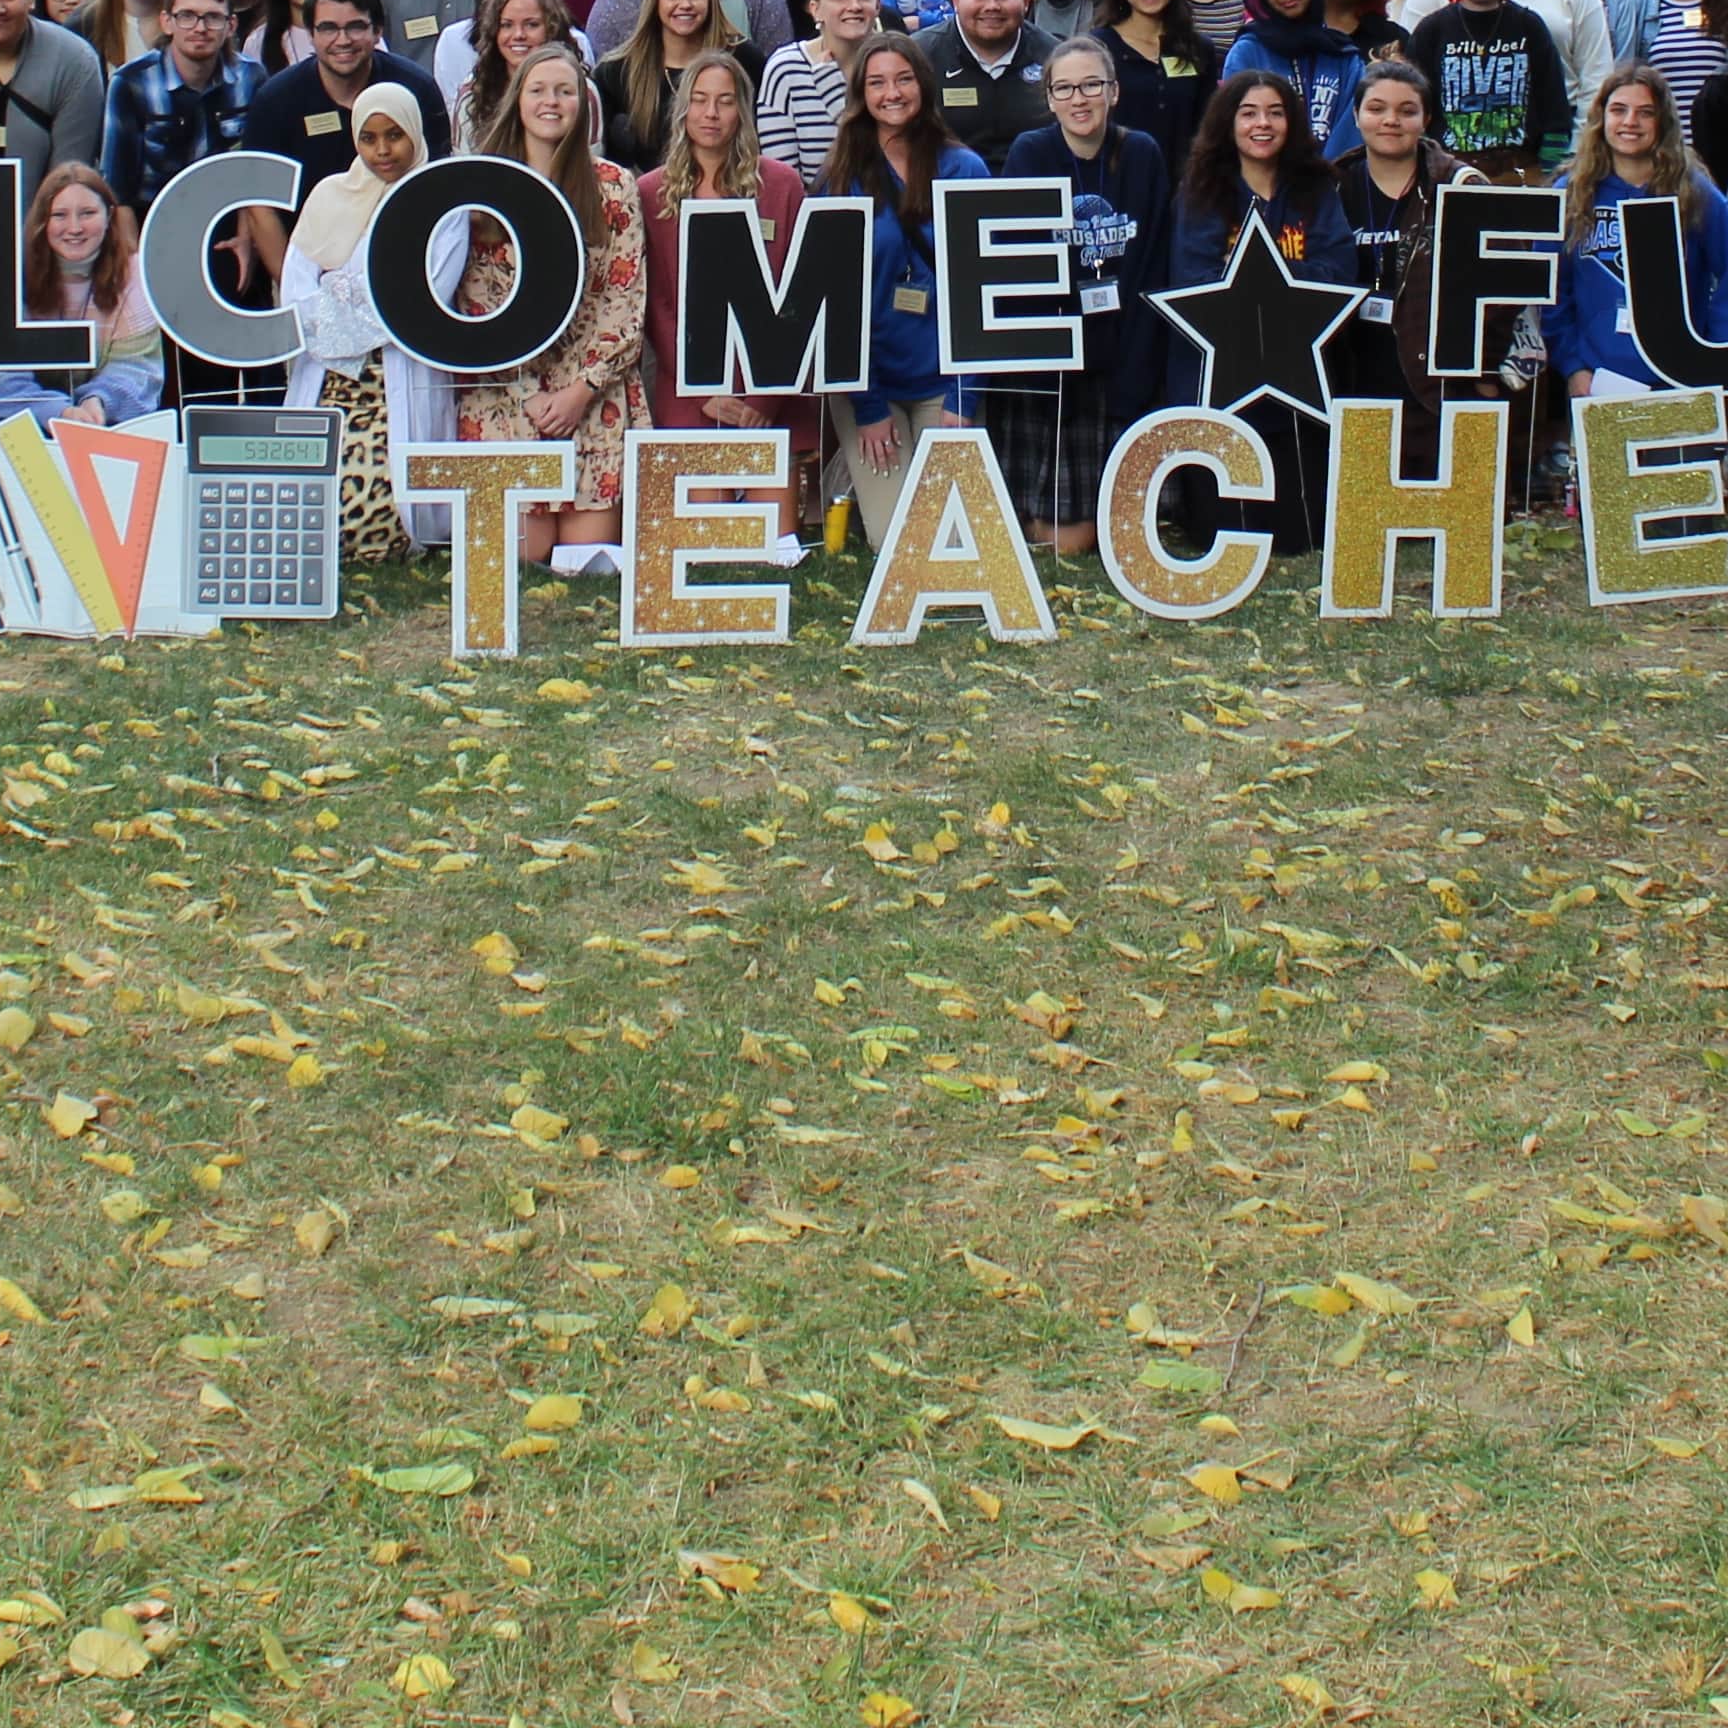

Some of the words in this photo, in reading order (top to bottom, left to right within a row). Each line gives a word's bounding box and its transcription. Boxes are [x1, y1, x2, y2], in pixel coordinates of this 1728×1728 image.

[1446, 41, 1485, 56] Billy
[1489, 36, 1527, 53] Joel
[1443, 52, 1529, 112] RIVER
